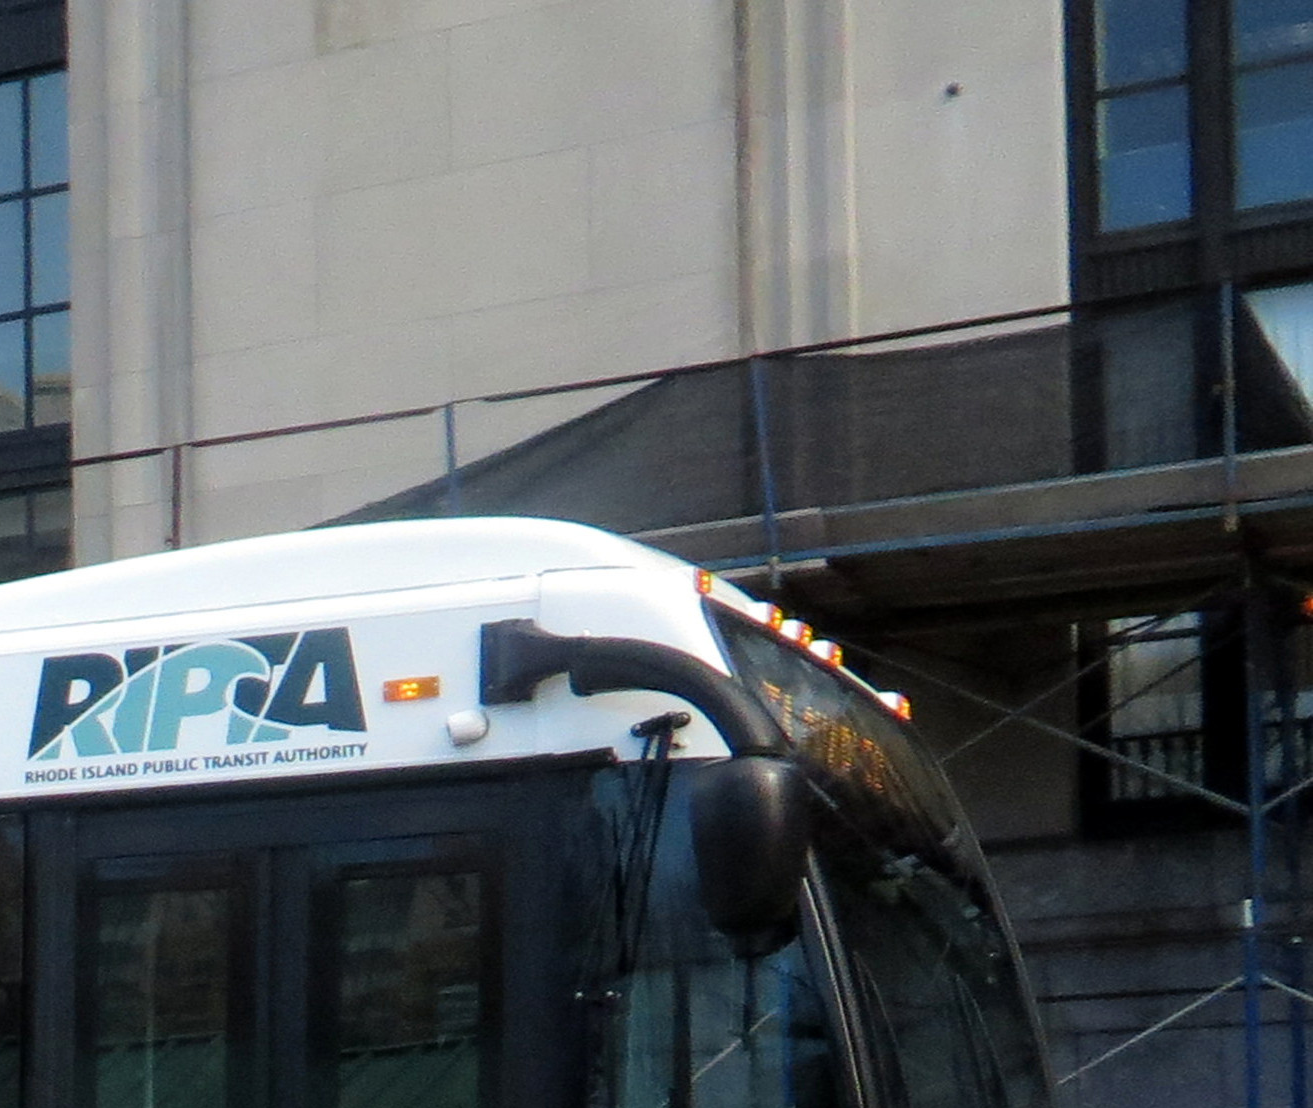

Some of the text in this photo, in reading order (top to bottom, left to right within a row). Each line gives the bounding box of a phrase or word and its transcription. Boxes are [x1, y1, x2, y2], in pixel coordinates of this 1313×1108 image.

[24, 743, 368, 784] RHODE ISLAND PUBLIC TRANSIT AUTHORITY
